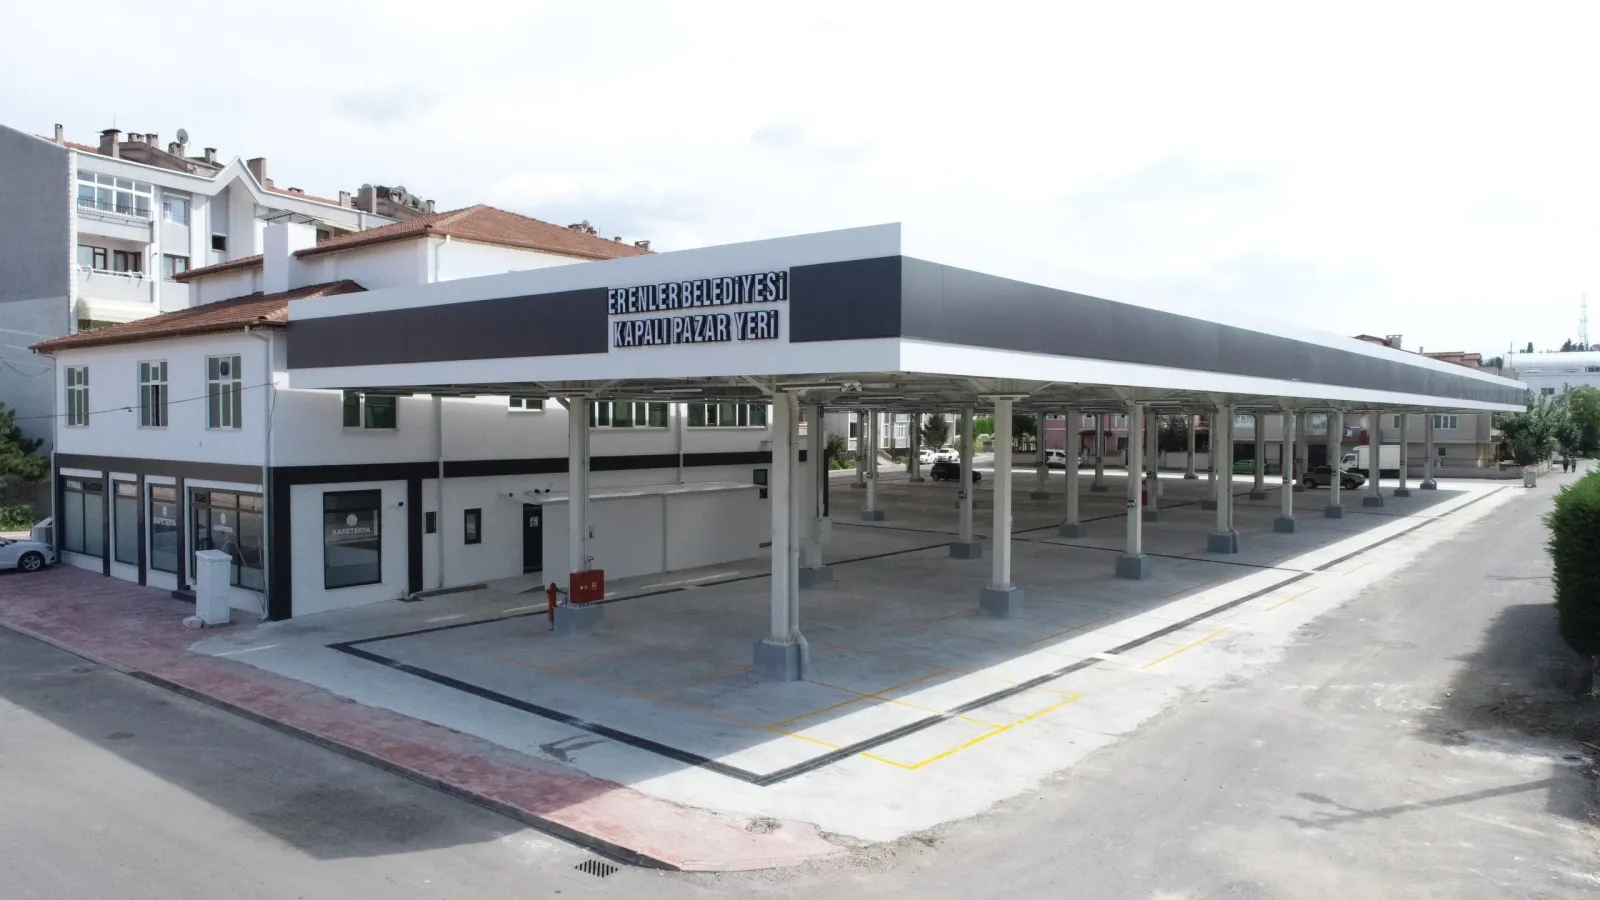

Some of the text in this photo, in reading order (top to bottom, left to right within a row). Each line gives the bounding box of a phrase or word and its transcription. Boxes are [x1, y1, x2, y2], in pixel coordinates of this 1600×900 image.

[608, 271, 787, 315] ERENLER BELEDİYESİ
[614, 310, 778, 347] KAPALI PAZAR YERİ
[332, 527, 371, 535] KAFETERYA
